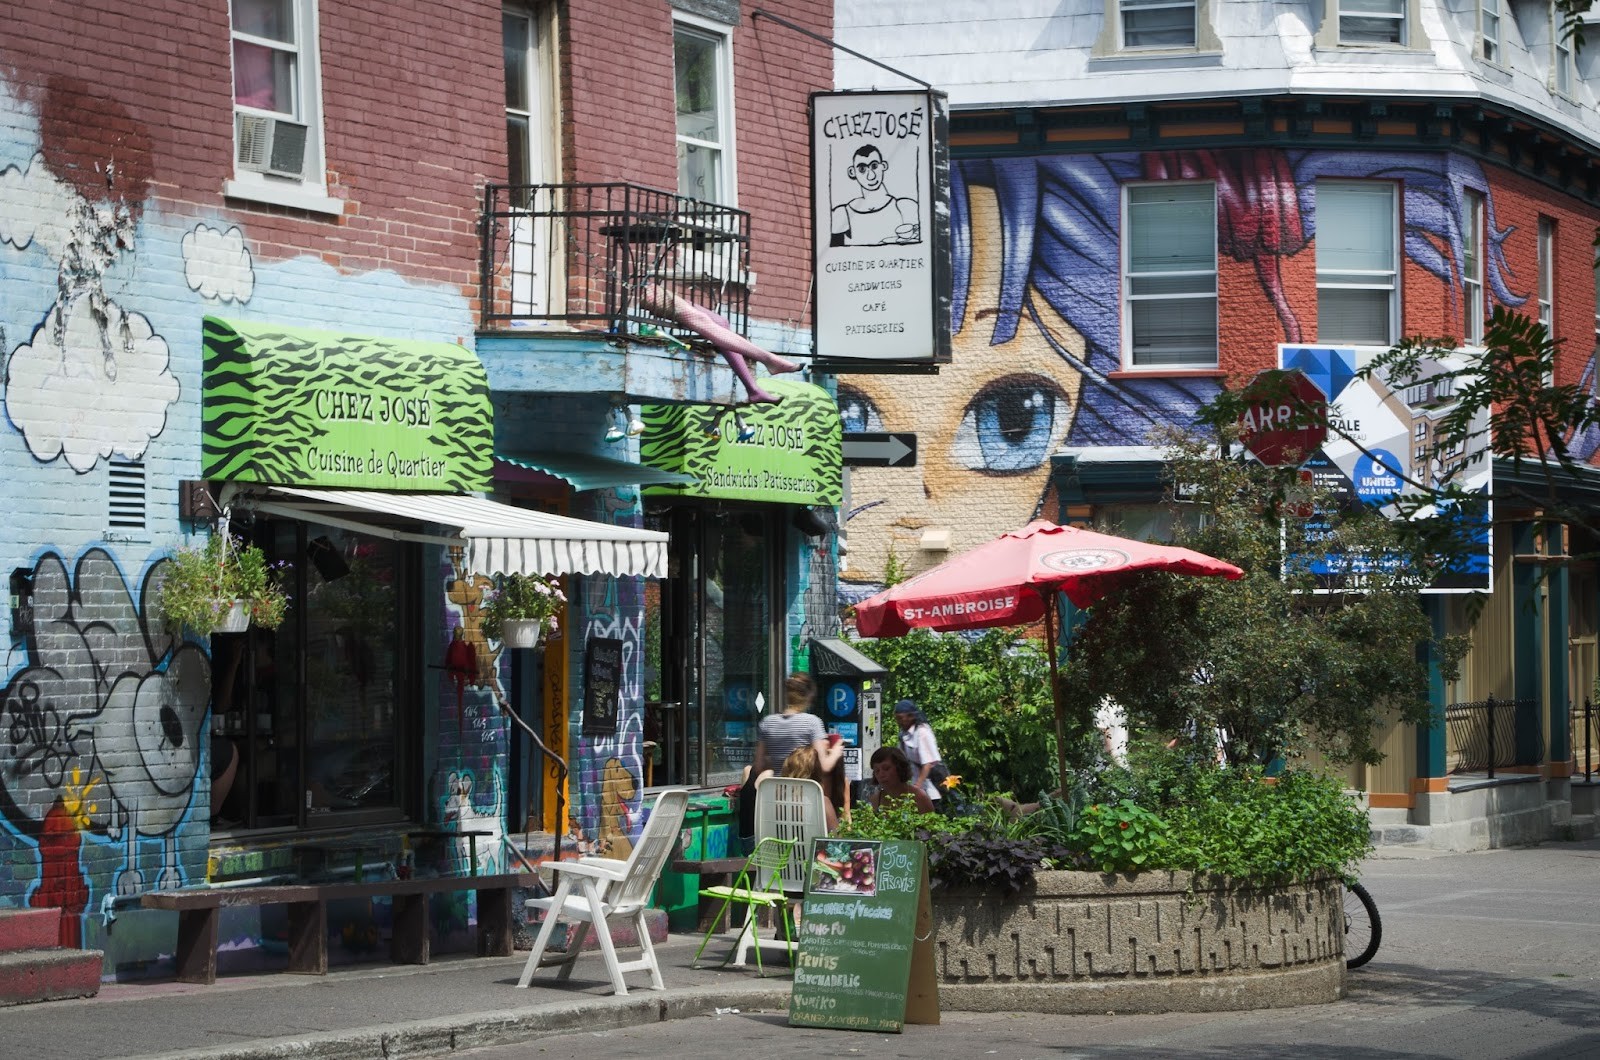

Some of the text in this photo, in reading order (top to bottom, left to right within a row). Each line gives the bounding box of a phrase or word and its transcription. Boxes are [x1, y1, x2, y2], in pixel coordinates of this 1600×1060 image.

[823, 107, 924, 140] CHEZ JOSÉ
[825, 257, 925, 273] CUISINE DE QUARTIER
[848, 280, 903, 293] SANDWICHS
[862, 301, 887, 312] CAFÉ
[845, 322, 905, 336] PATISSERIES
[316, 388, 432, 427] CHEZ JOSÉ
[1243, 405, 1319, 432] ARR
[768, 422, 804, 451] JOSÉ
[307, 446, 446, 479] Cuisine de Quartier
[1371, 454, 1387, 476] 6
[706, 466, 816, 494] Sandwichs Patisseries
[1362, 475, 1396, 487] UNITÉS
[903, 597, 1014, 620] ST-AMBROISE
[831, 922, 846, 936] FU
